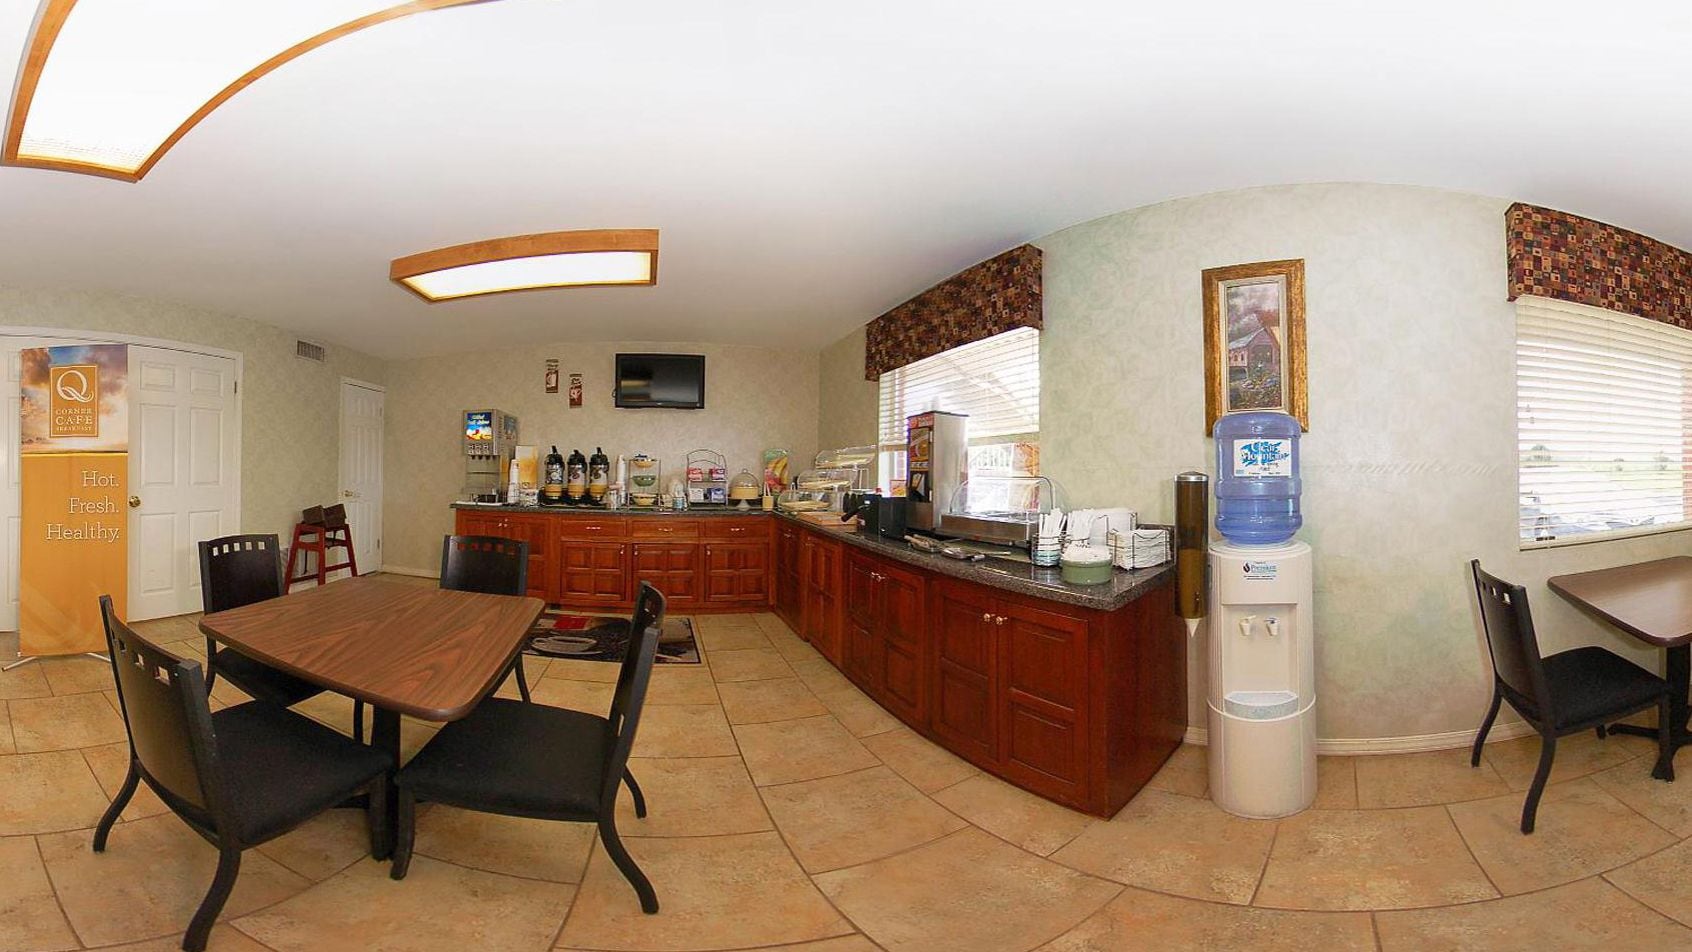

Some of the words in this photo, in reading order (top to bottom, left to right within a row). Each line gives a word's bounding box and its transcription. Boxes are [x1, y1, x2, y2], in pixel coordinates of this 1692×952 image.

[57, 370, 94, 402] Q
[82, 470, 119, 487] Hot.
[69, 496, 119, 514] Fresh.
[46, 521, 119, 543] Healthy.
